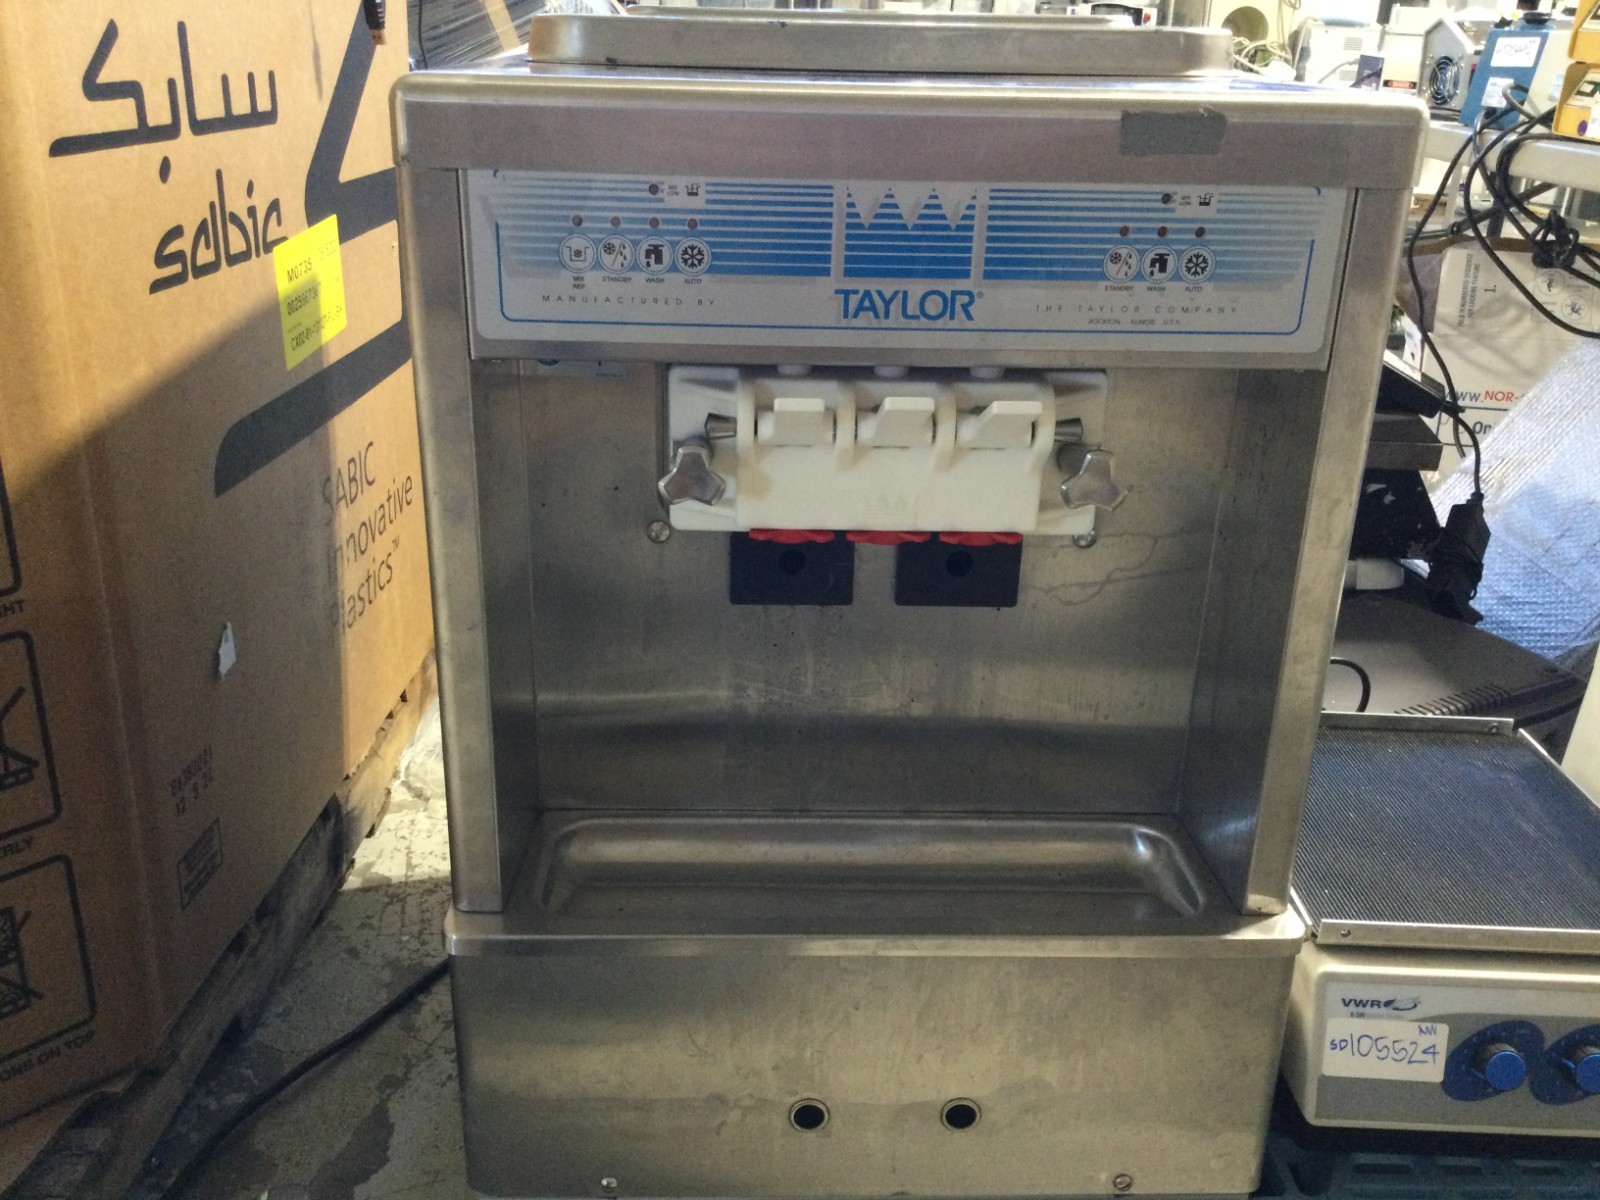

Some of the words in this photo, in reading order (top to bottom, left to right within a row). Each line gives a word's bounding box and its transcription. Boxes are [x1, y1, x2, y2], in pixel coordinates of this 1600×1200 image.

[286, 257, 313, 284] M0735
[1104, 285, 1134, 293] STANDBY
[1146, 285, 1166, 293] WASH
[542, 294, 683, 306] MANUFACTURED
[834, 288, 976, 321] TAYLOR
[1036, 304, 1062, 313] THE
[1078, 305, 1140, 313] TAYLOR
[1155, 305, 1237, 314] COMPANY
[321, 440, 377, 527] SABIC
[1341, 997, 1383, 1009] VWR
